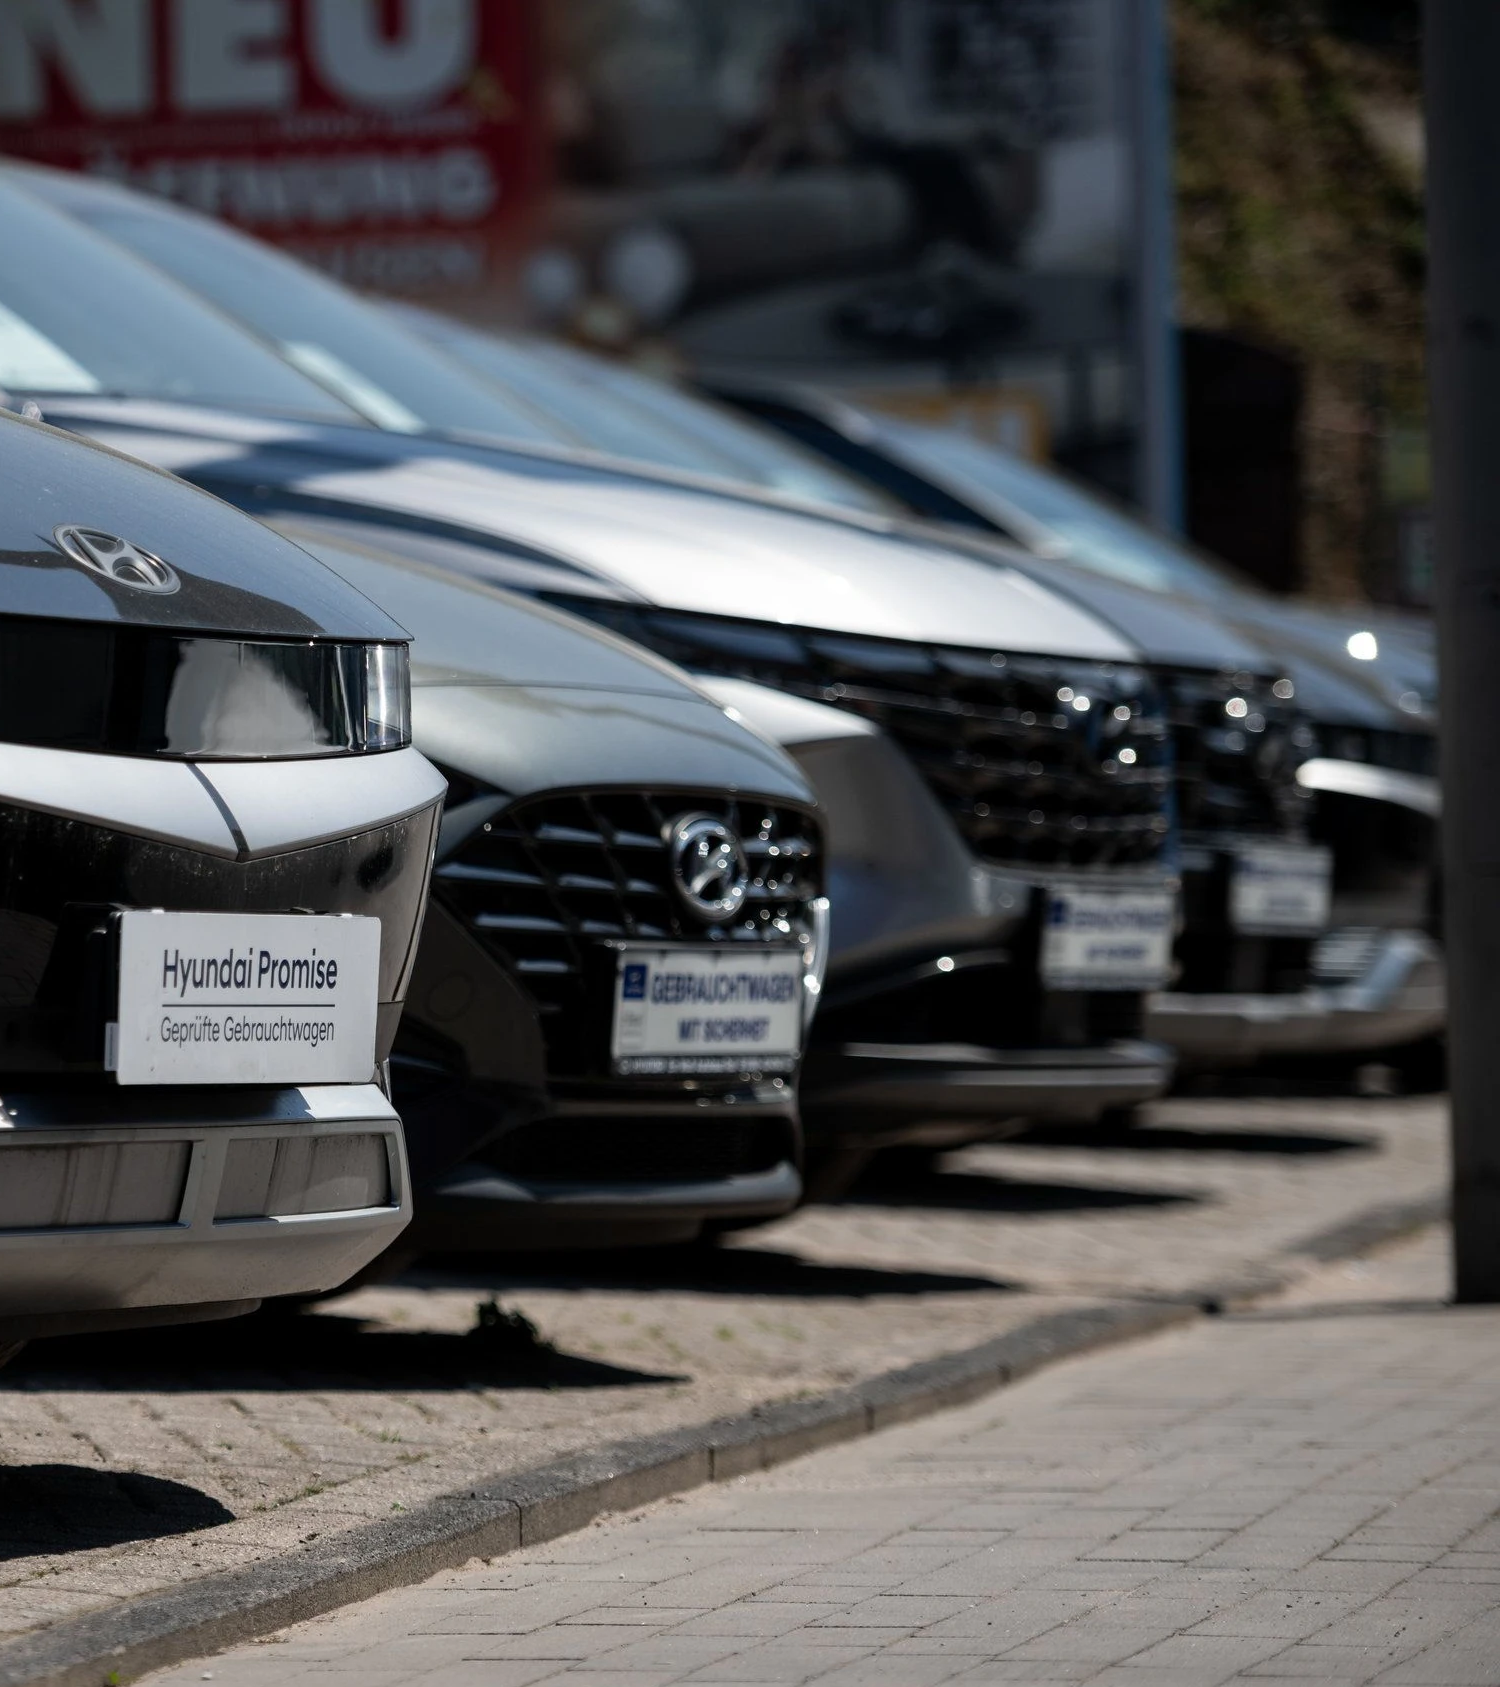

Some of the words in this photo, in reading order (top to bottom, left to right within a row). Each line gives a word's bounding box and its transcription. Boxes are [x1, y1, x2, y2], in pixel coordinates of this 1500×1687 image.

[162, 948, 253, 998] Hyundai
[258, 948, 338, 989] Promise
[652, 973, 795, 1004] GEBRAUCHTWAGEN
[160, 1016, 221, 1049] Geprüfte
[223, 1015, 335, 1048] Gebrauchtwagen
